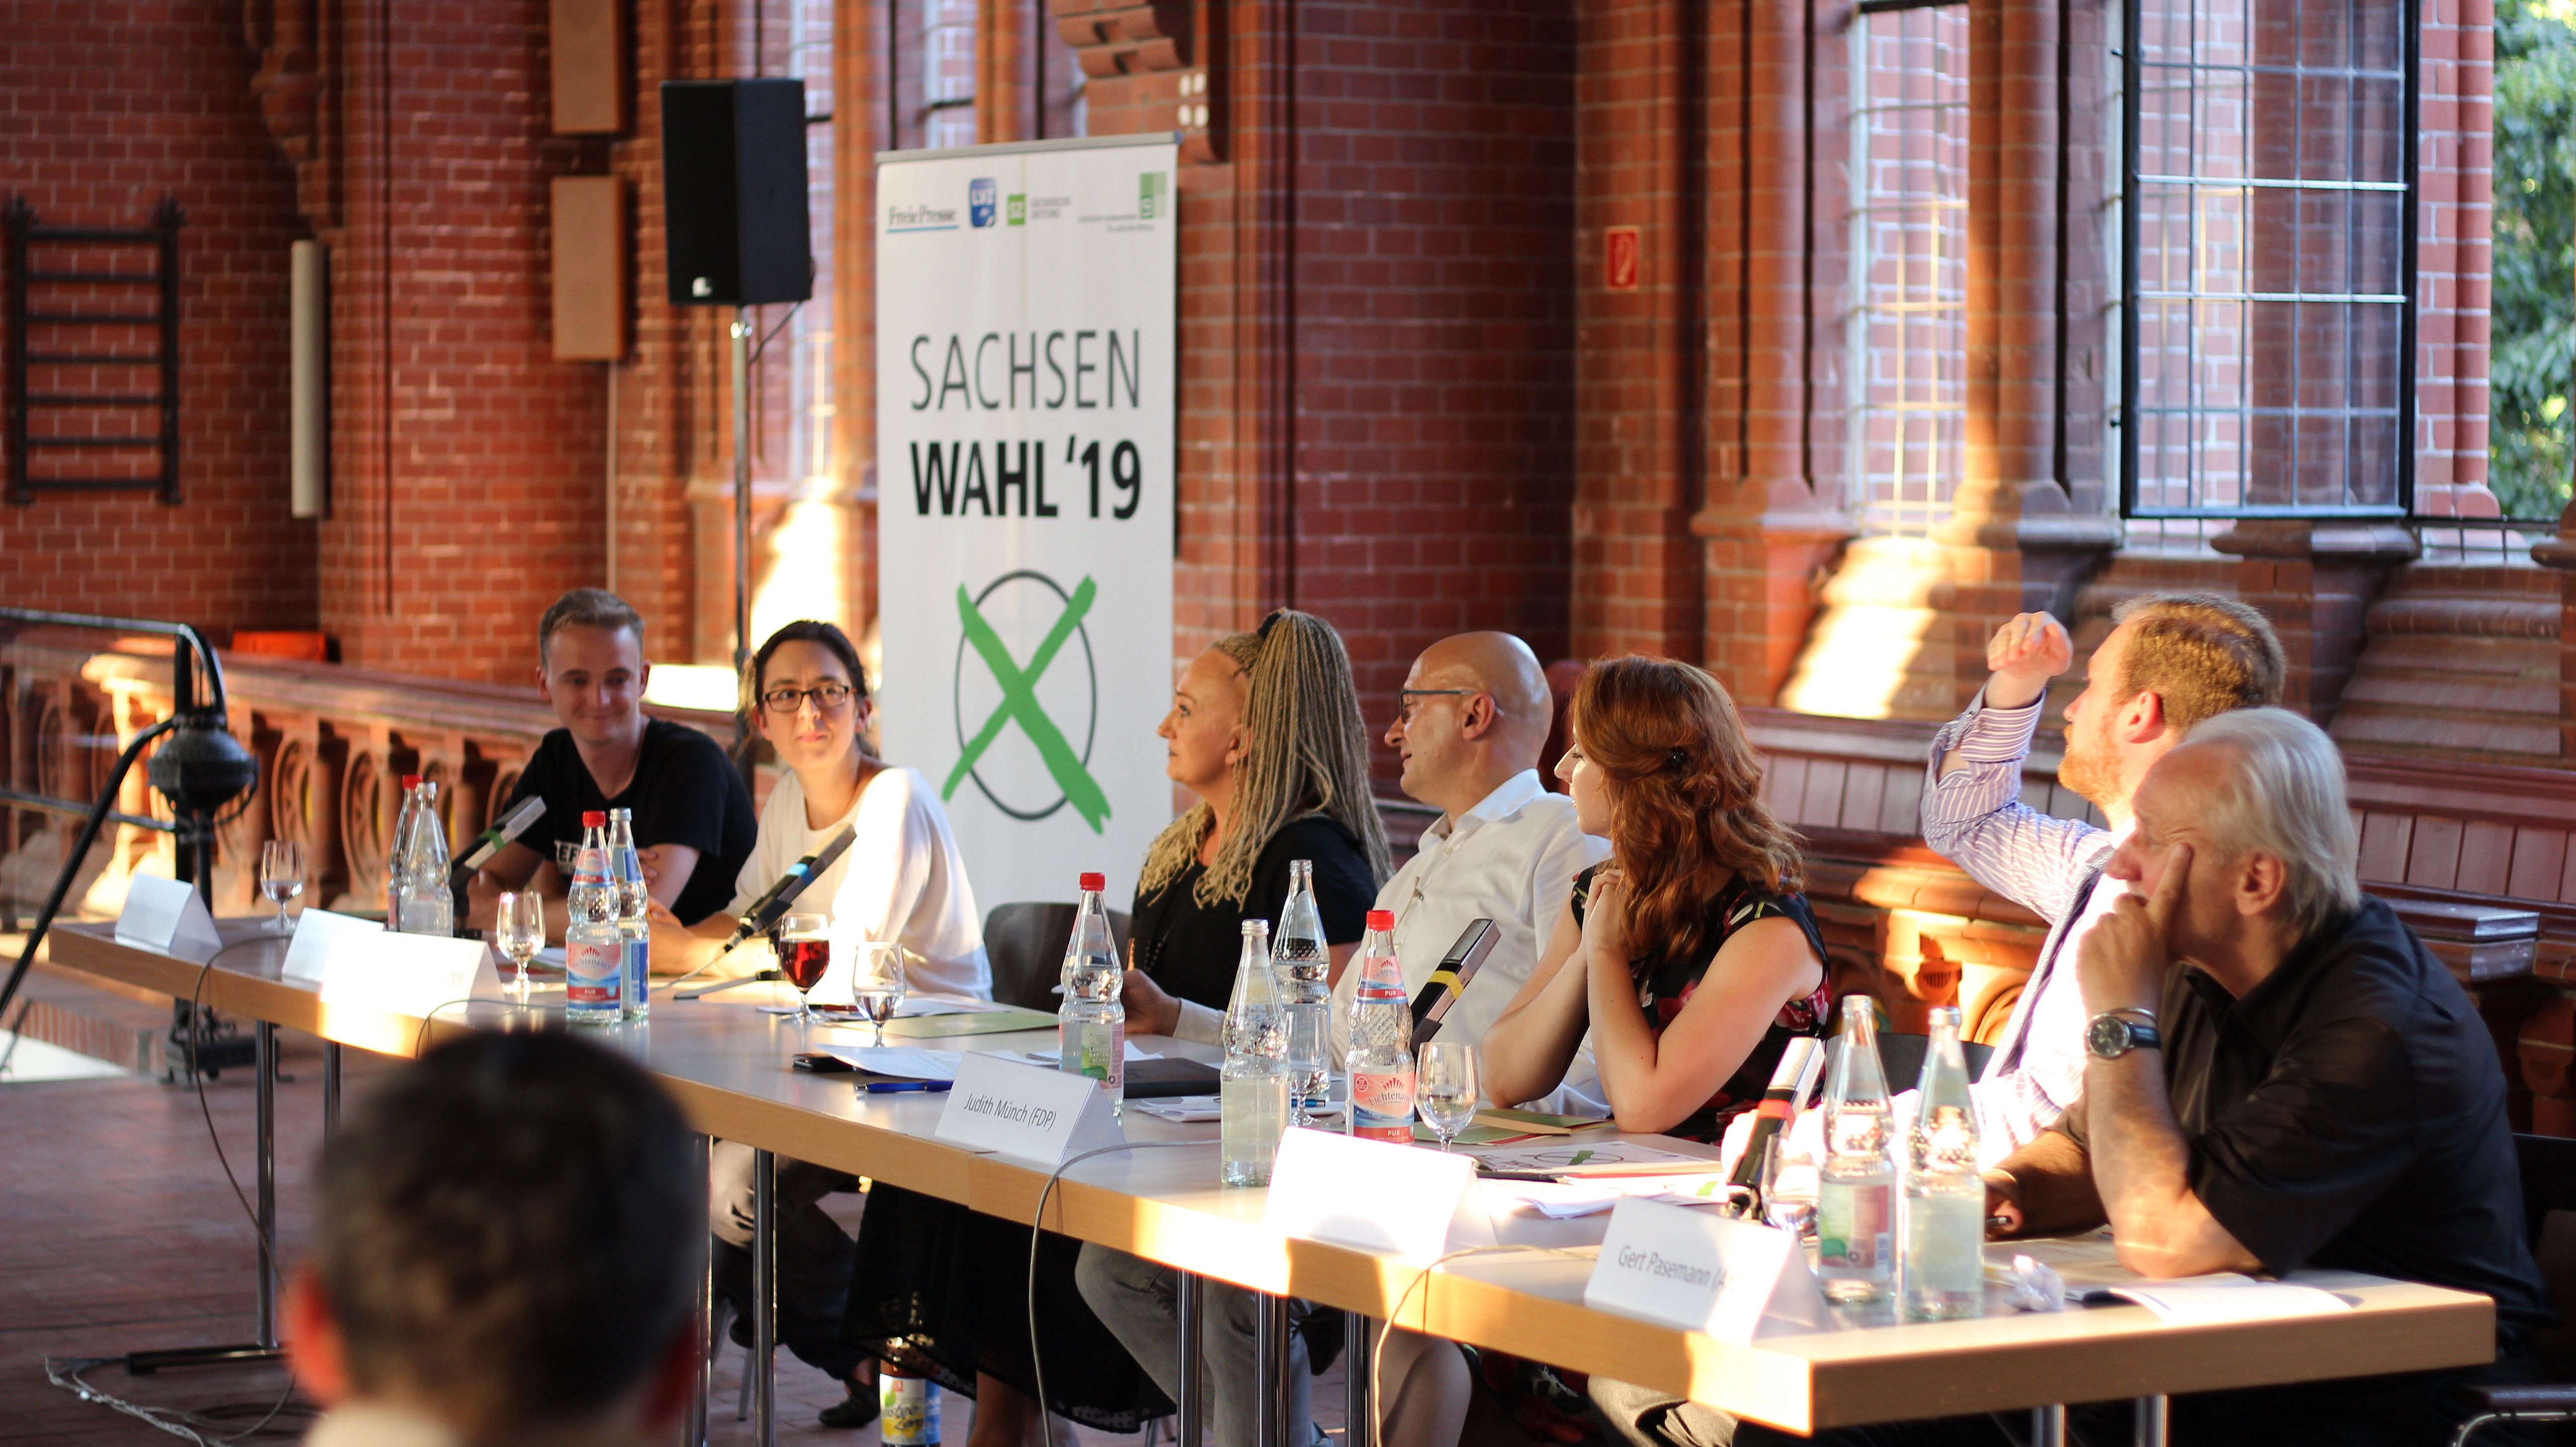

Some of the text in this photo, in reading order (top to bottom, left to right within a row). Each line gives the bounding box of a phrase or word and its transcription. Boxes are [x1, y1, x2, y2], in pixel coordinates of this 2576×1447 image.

[911, 329, 1140, 411] SACHSEN
[964, 1093, 1058, 1132] Judith Münch (FDP)
[1368, 1092, 1412, 1106] Lichtenauer
[1618, 1245, 1647, 1271] Gert
[1647, 1252, 1711, 1286] Pasemann
